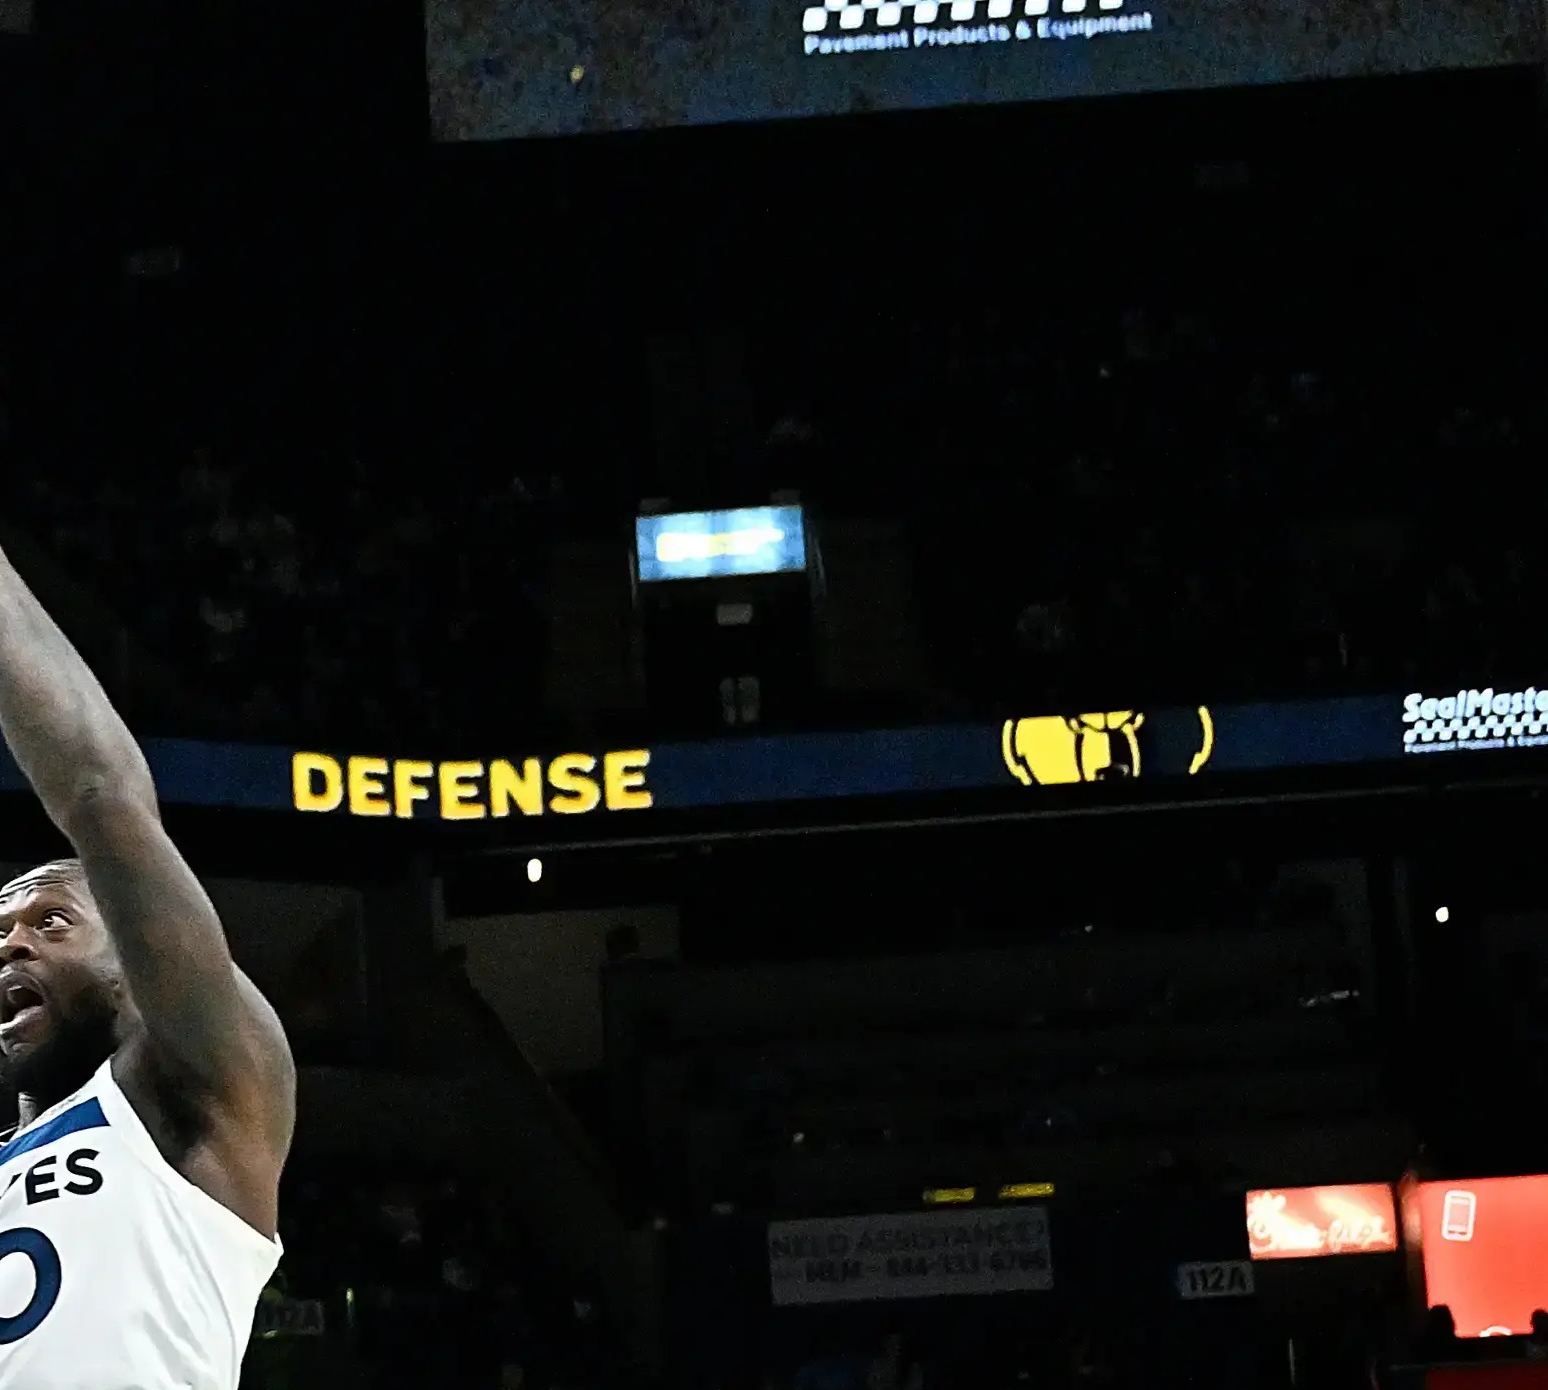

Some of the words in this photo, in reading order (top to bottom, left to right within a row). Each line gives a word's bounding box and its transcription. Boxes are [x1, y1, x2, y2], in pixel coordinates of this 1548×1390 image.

[804, 31, 909, 55] Pavement
[913, 24, 1011, 47] Products
[1015, 19, 1031, 40] &
[1037, 12, 1152, 40] Equipment
[292, 750, 653, 820] DEFENSE
